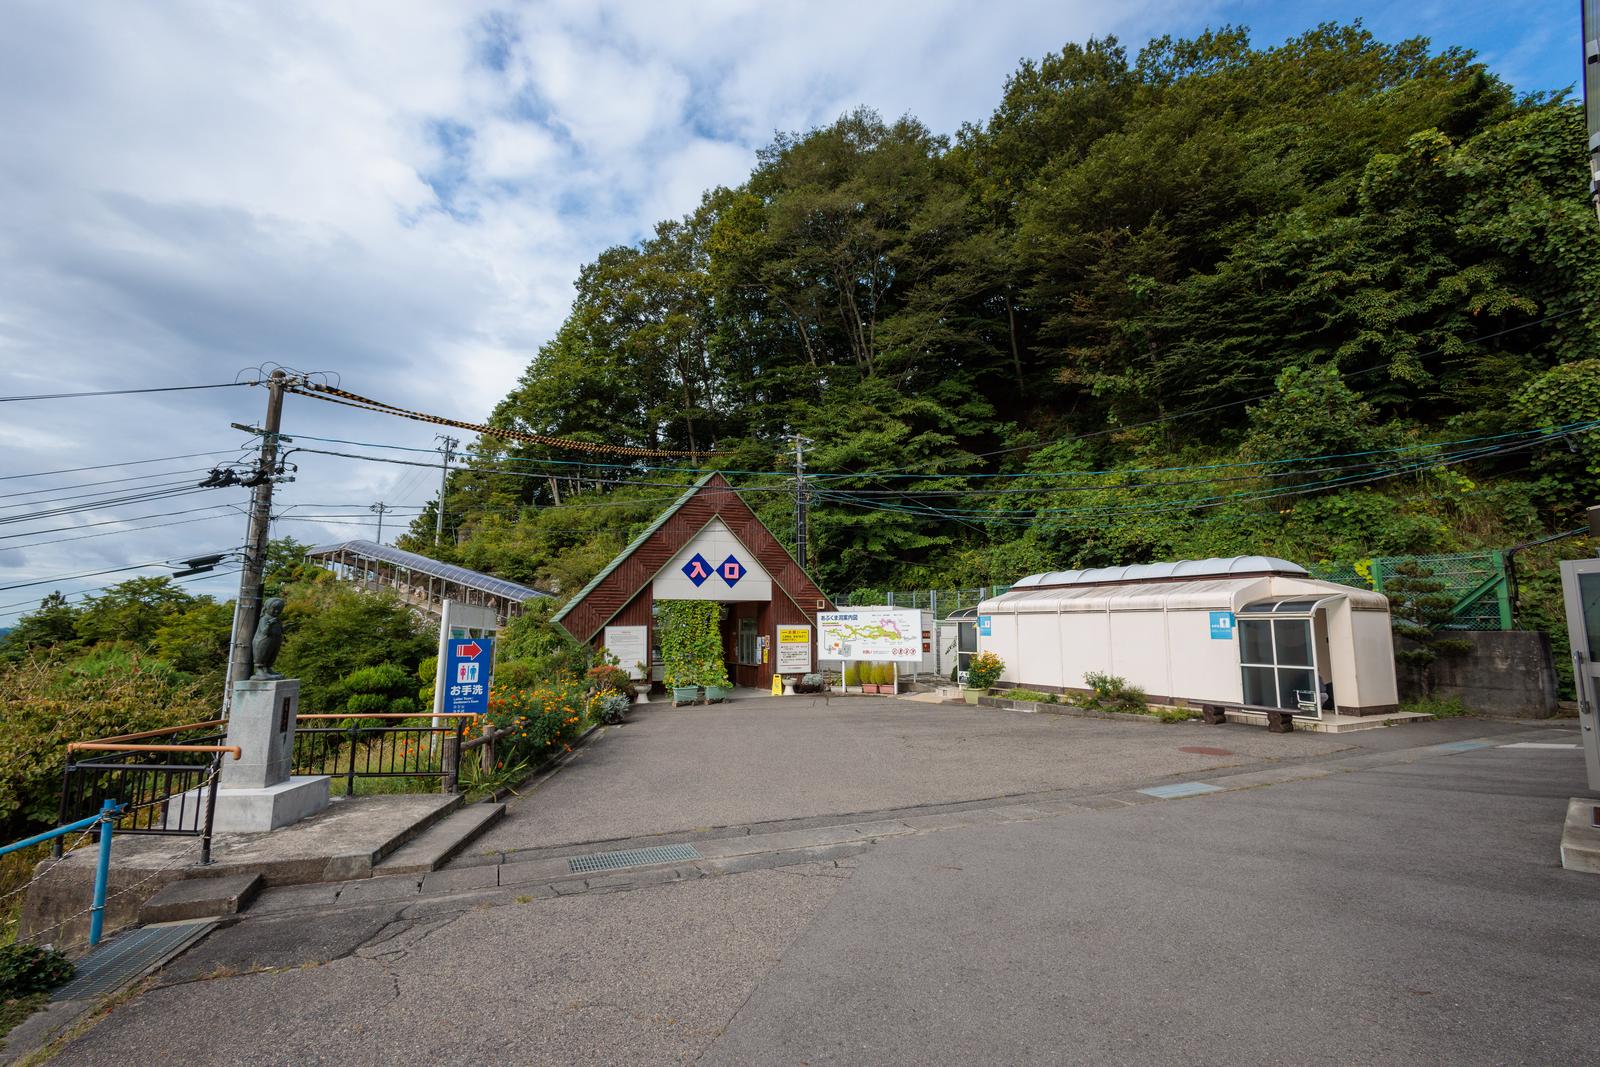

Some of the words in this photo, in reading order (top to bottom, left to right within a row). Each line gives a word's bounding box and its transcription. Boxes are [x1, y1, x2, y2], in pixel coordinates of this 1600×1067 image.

[690, 561, 739, 579] 入口
[450, 684, 483, 696] お手洗
